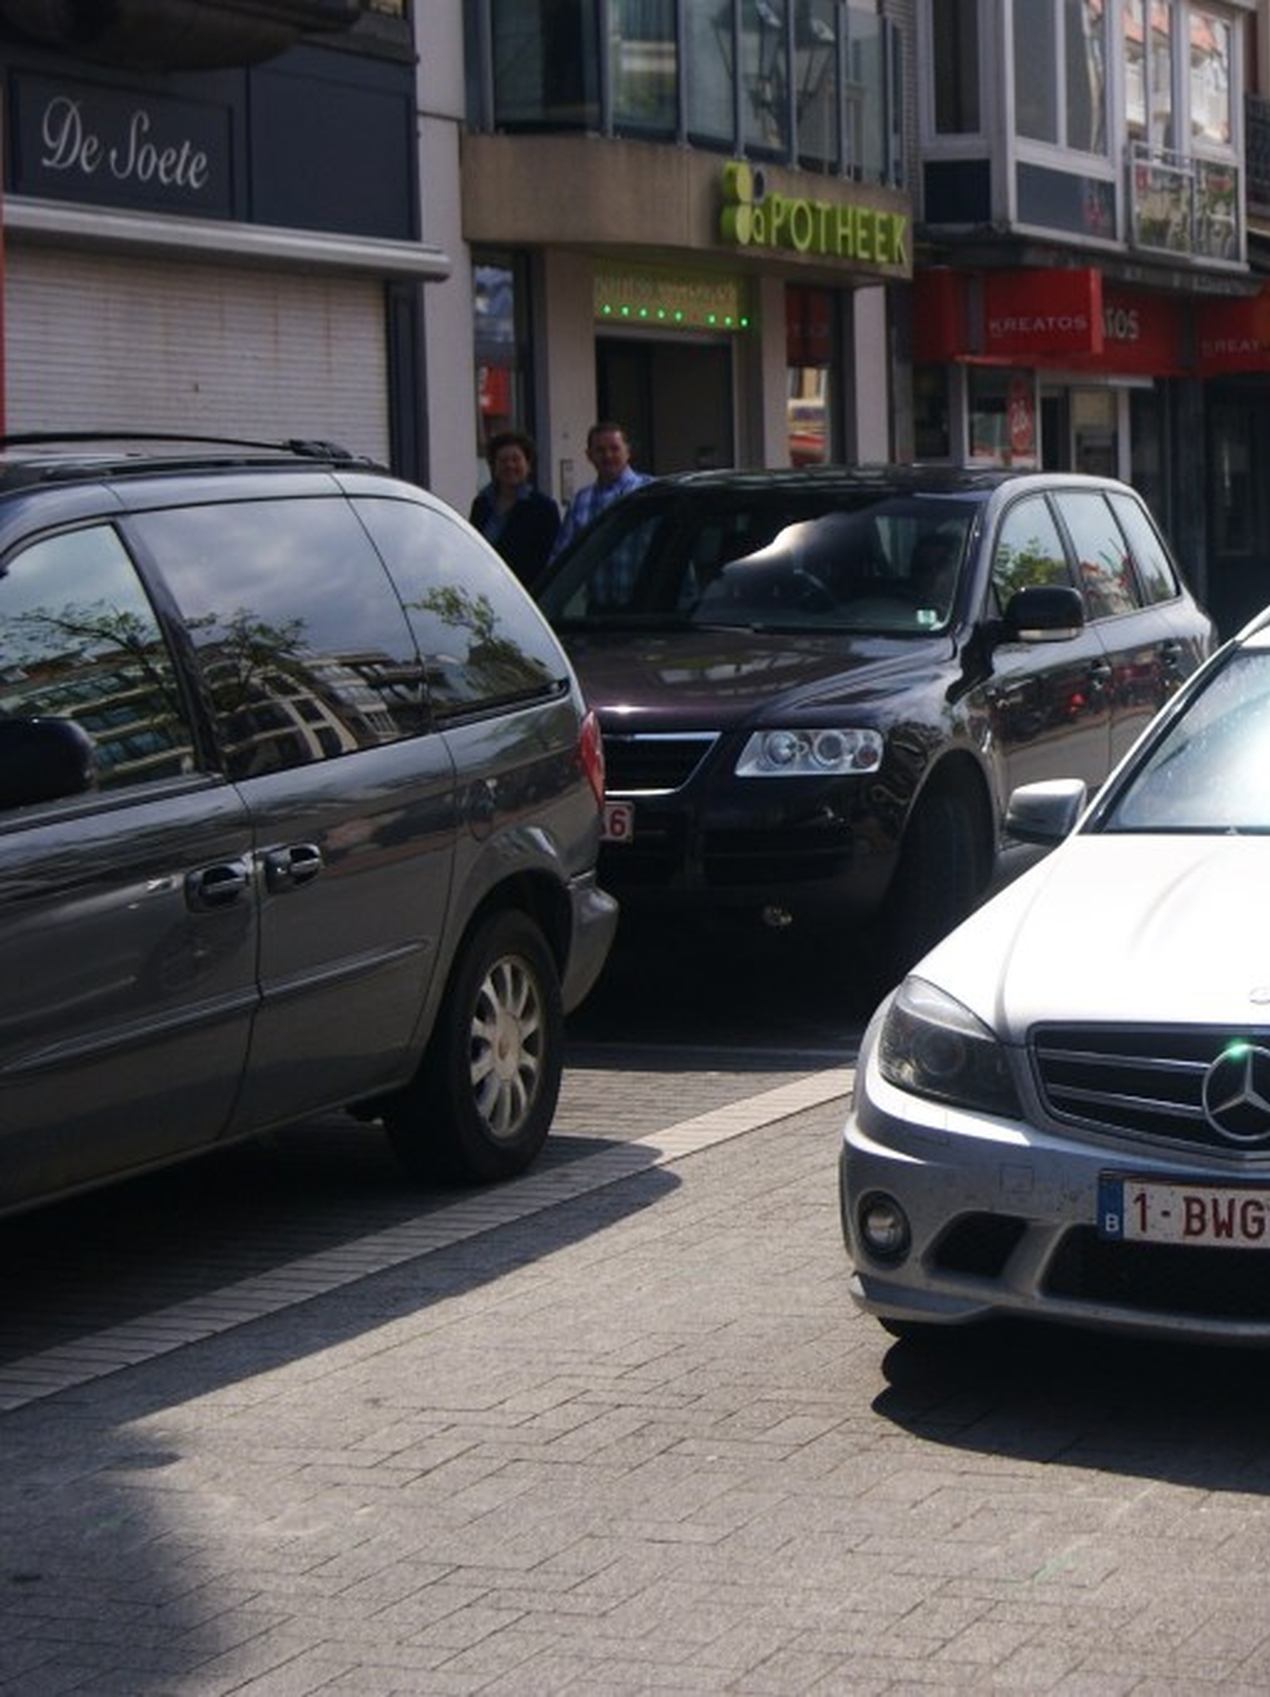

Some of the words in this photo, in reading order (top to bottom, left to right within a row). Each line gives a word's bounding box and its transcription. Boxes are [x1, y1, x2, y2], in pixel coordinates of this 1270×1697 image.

[42, 97, 99, 173] De
[110, 111, 209, 189] Soete
[990, 315, 1087, 338] KREATOS
[1105, 1215, 1119, 1232] B
